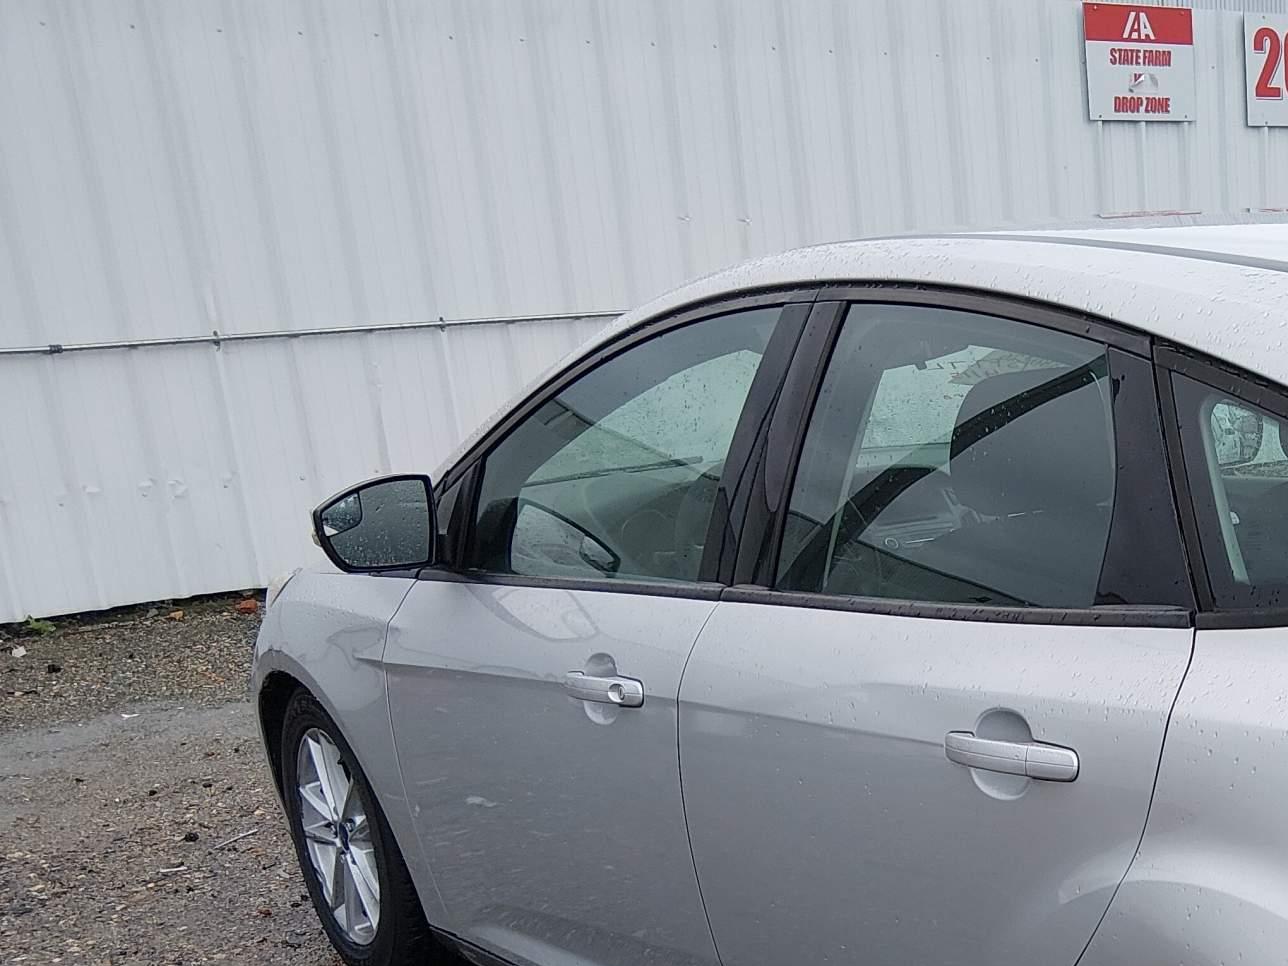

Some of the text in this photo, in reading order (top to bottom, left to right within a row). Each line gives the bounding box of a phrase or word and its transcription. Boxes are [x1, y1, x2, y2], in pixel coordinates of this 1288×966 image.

[1109, 47, 1172, 67] STATE FARM
[1114, 96, 1170, 114] DROP ZONE
